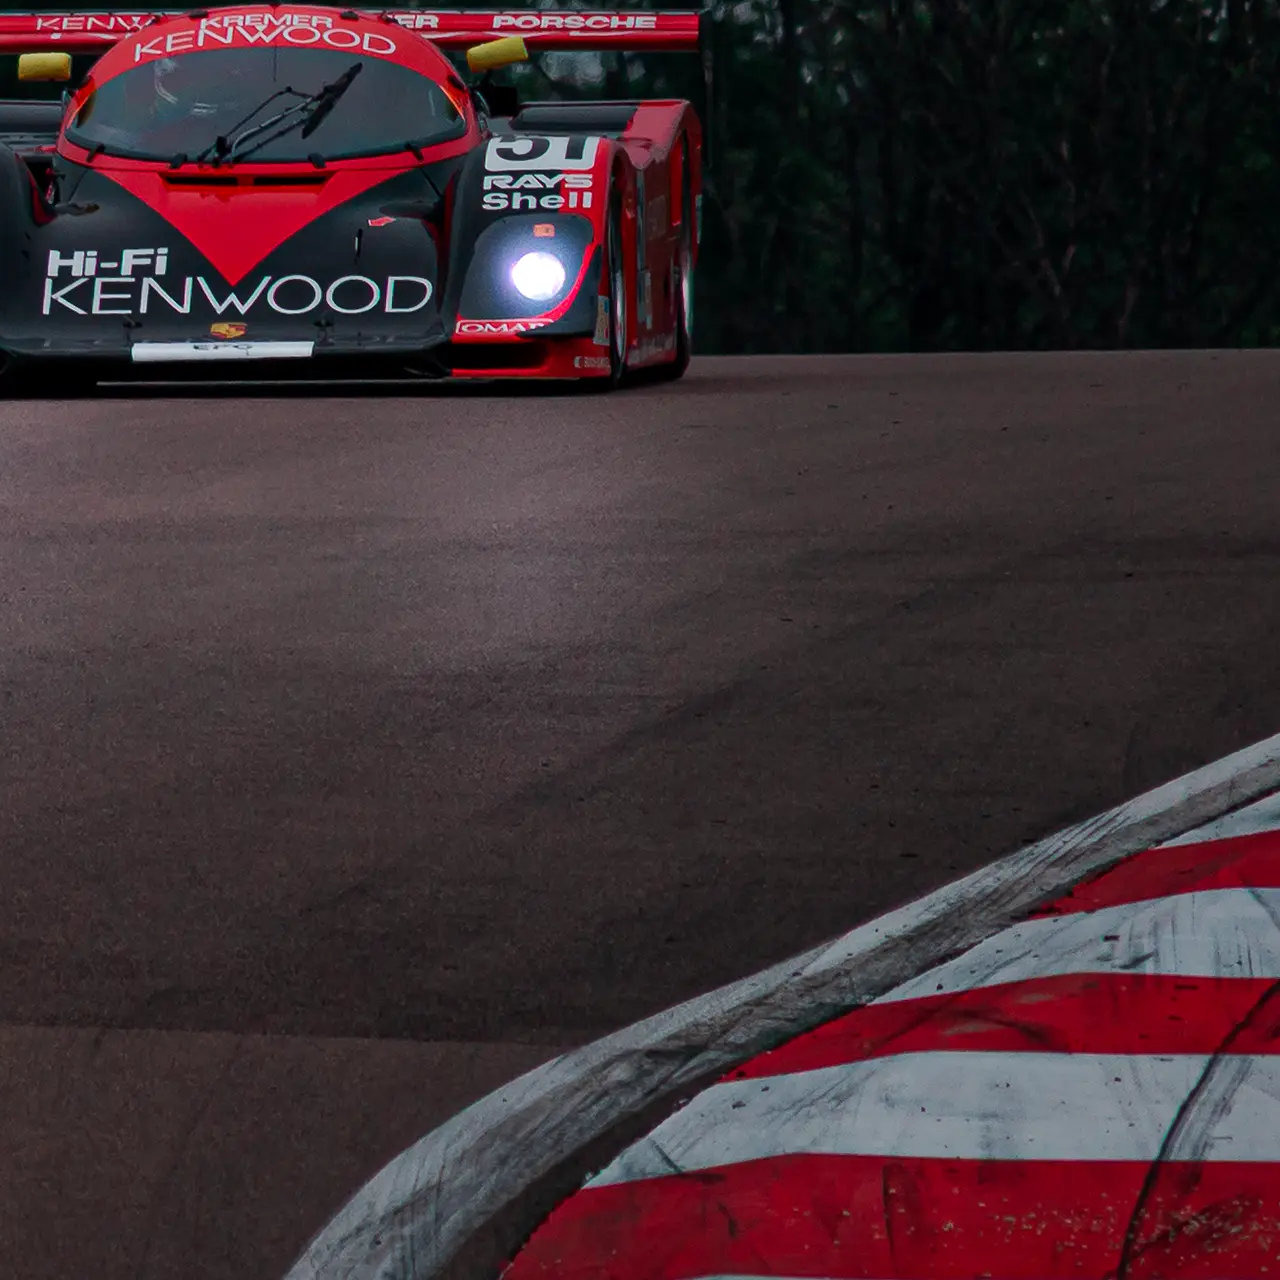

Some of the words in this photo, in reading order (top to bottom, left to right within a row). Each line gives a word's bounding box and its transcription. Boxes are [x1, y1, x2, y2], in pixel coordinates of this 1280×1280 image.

[200, 13, 333, 29] KREMER
[492, 15, 657, 29] PORSCHE
[134, 24, 396, 63] KENWOOD
[482, 174, 593, 190] RAYS
[482, 191, 593, 210] Shell
[47, 248, 169, 276] Hi-Fi
[42, 275, 434, 315] KENWOOD
